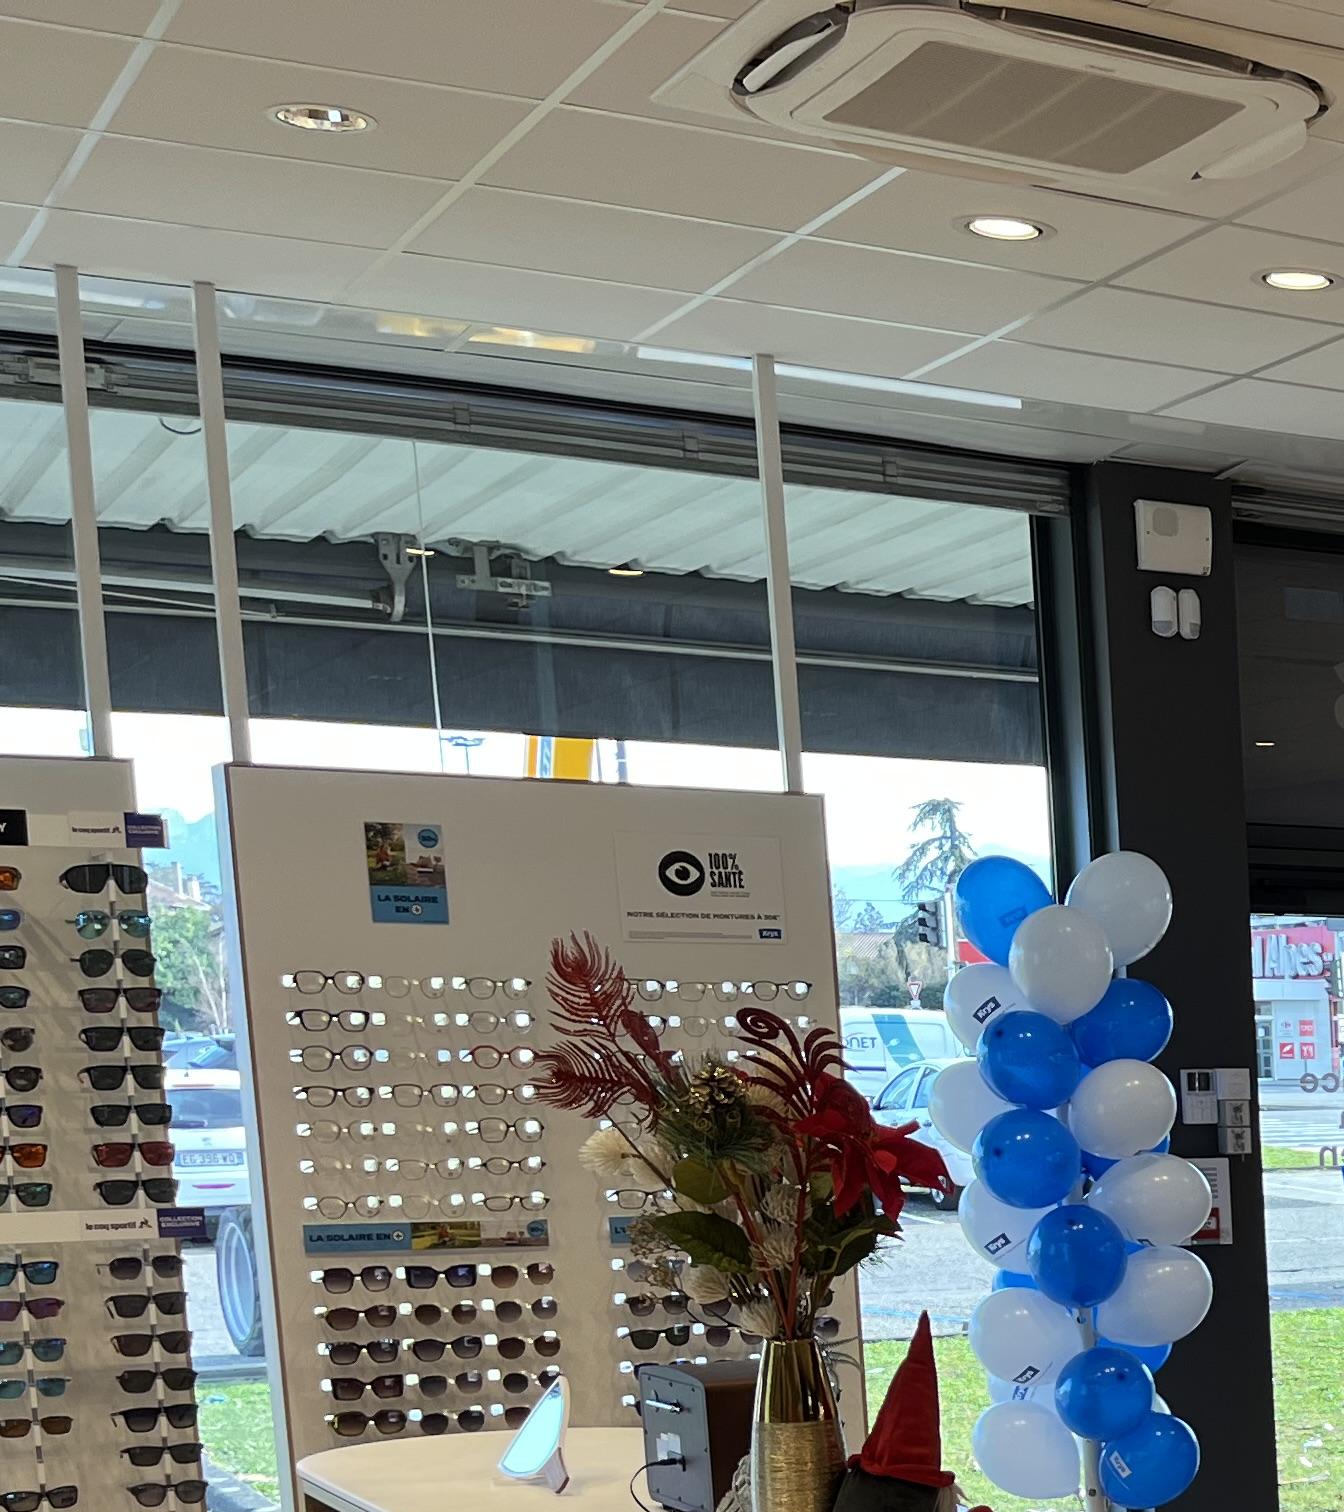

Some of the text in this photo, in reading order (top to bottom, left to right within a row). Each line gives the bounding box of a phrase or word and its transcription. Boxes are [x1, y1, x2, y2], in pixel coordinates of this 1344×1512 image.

[708, 852, 740, 872] 100%
[710, 870, 745, 889] SANTÉ
[377, 894, 440, 903] LA SOLAIRE
[309, 1232, 391, 1243] LA SOLAIRE EN
